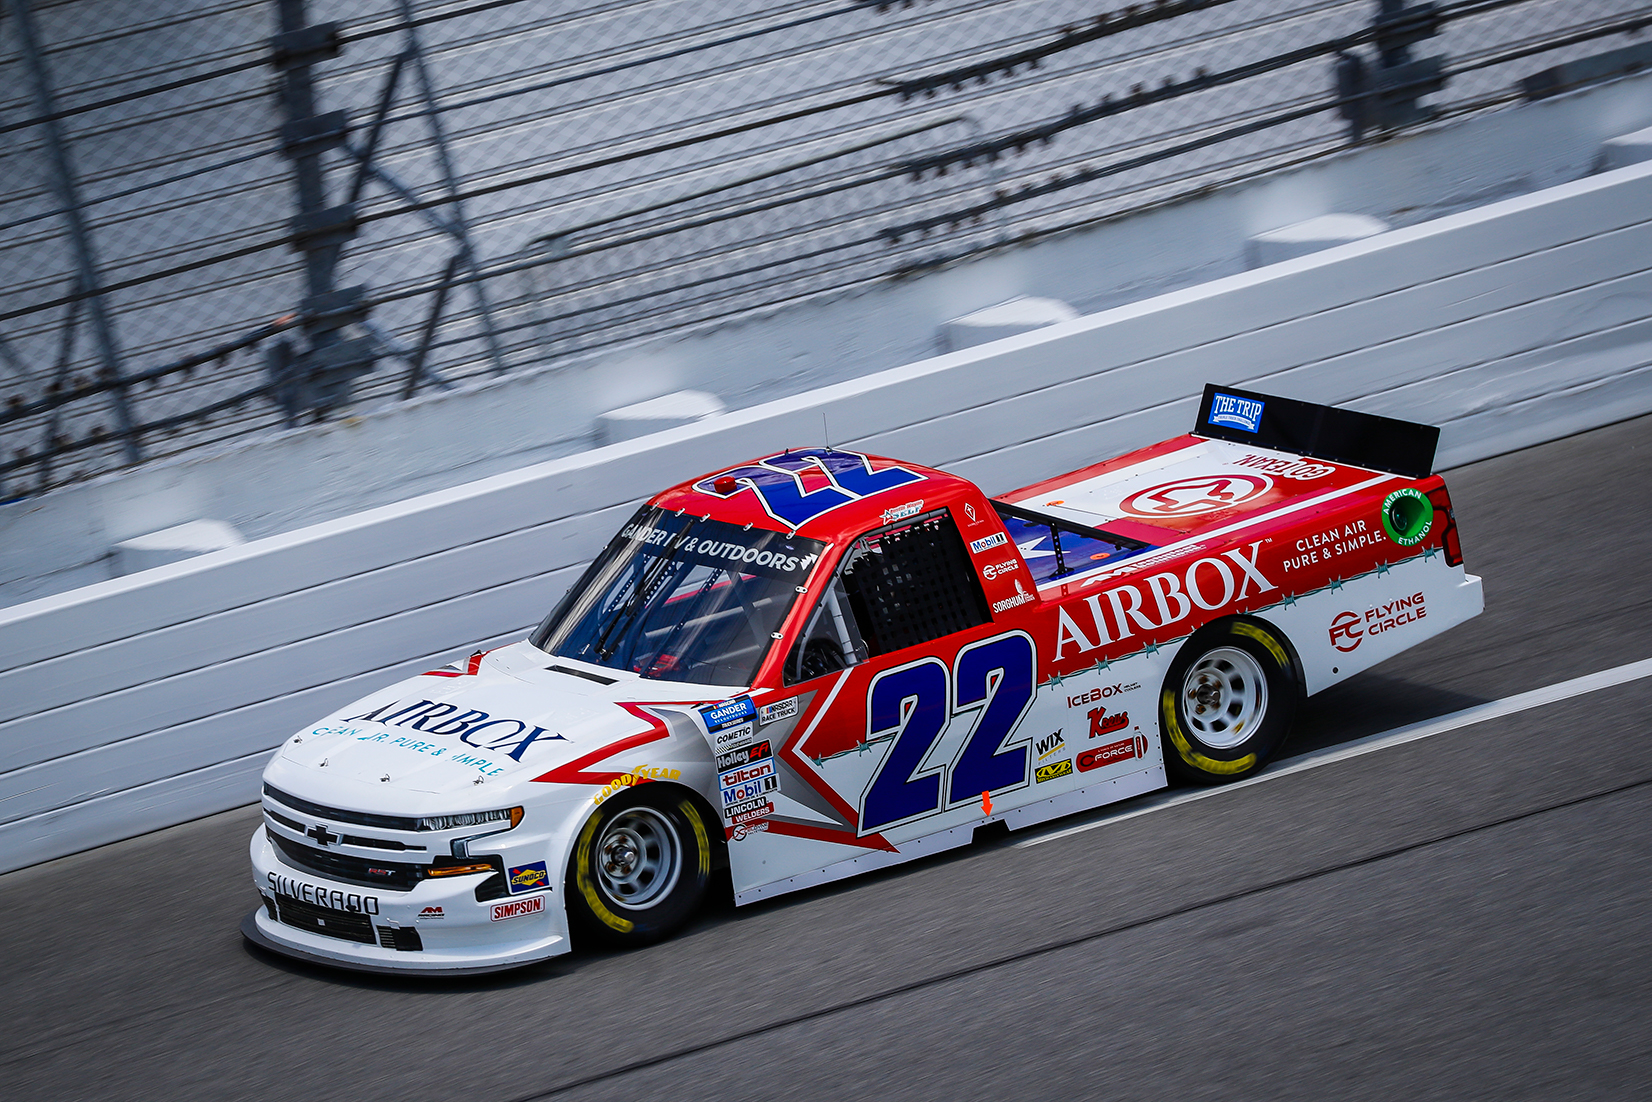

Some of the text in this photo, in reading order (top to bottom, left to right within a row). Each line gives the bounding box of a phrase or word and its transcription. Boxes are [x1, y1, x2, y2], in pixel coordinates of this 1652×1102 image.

[1214, 395, 1236, 414] THE
[1237, 399, 1262, 422] TRIP
[692, 447, 929, 531] 22
[1383, 488, 1422, 515] AMERICAN
[972, 536, 996, 551] Mobil
[1295, 519, 1367, 552] CLEAN AIR
[1398, 521, 1432, 546] ETHANOL
[621, 523, 668, 546] GANDER
[684, 537, 699, 553] &
[697, 540, 800, 572] OUTDOORS
[1283, 530, 1387, 573] PURE & SIMPLE.
[995, 559, 1018, 570] FLYING
[997, 564, 1019, 576] CIRCLE
[992, 594, 1026, 614] SORGHUM
[1051, 540, 1278, 663] AIRBOX
[1364, 591, 1426, 623] FLYING
[1329, 617, 1364, 647] FC
[1368, 606, 1427, 636] CIRCLE
[710, 702, 747, 720] GANDER
[761, 707, 795, 722] RACE TRUCK
[339, 699, 569, 763] AIRBOX
[716, 727, 751, 744] COMETIC
[858, 631, 1036, 838] 22
[1035, 727, 1065, 755] WIX
[390, 737, 434, 755] PURE
[431, 747, 447, 757] &
[449, 753, 505, 777] IMPLE
[717, 750, 750, 769] Holley
[593, 764, 681, 806] GOODYEAR
[722, 764, 771, 786] tilton
[723, 780, 761, 804] Mobil
[725, 798, 765, 818] LINCOLN
[735, 806, 770, 823] WELDERS
[512, 870, 546, 885] SUNOCO
[267, 871, 379, 916] SILVERADO
[494, 898, 542, 919] SIMPSON
